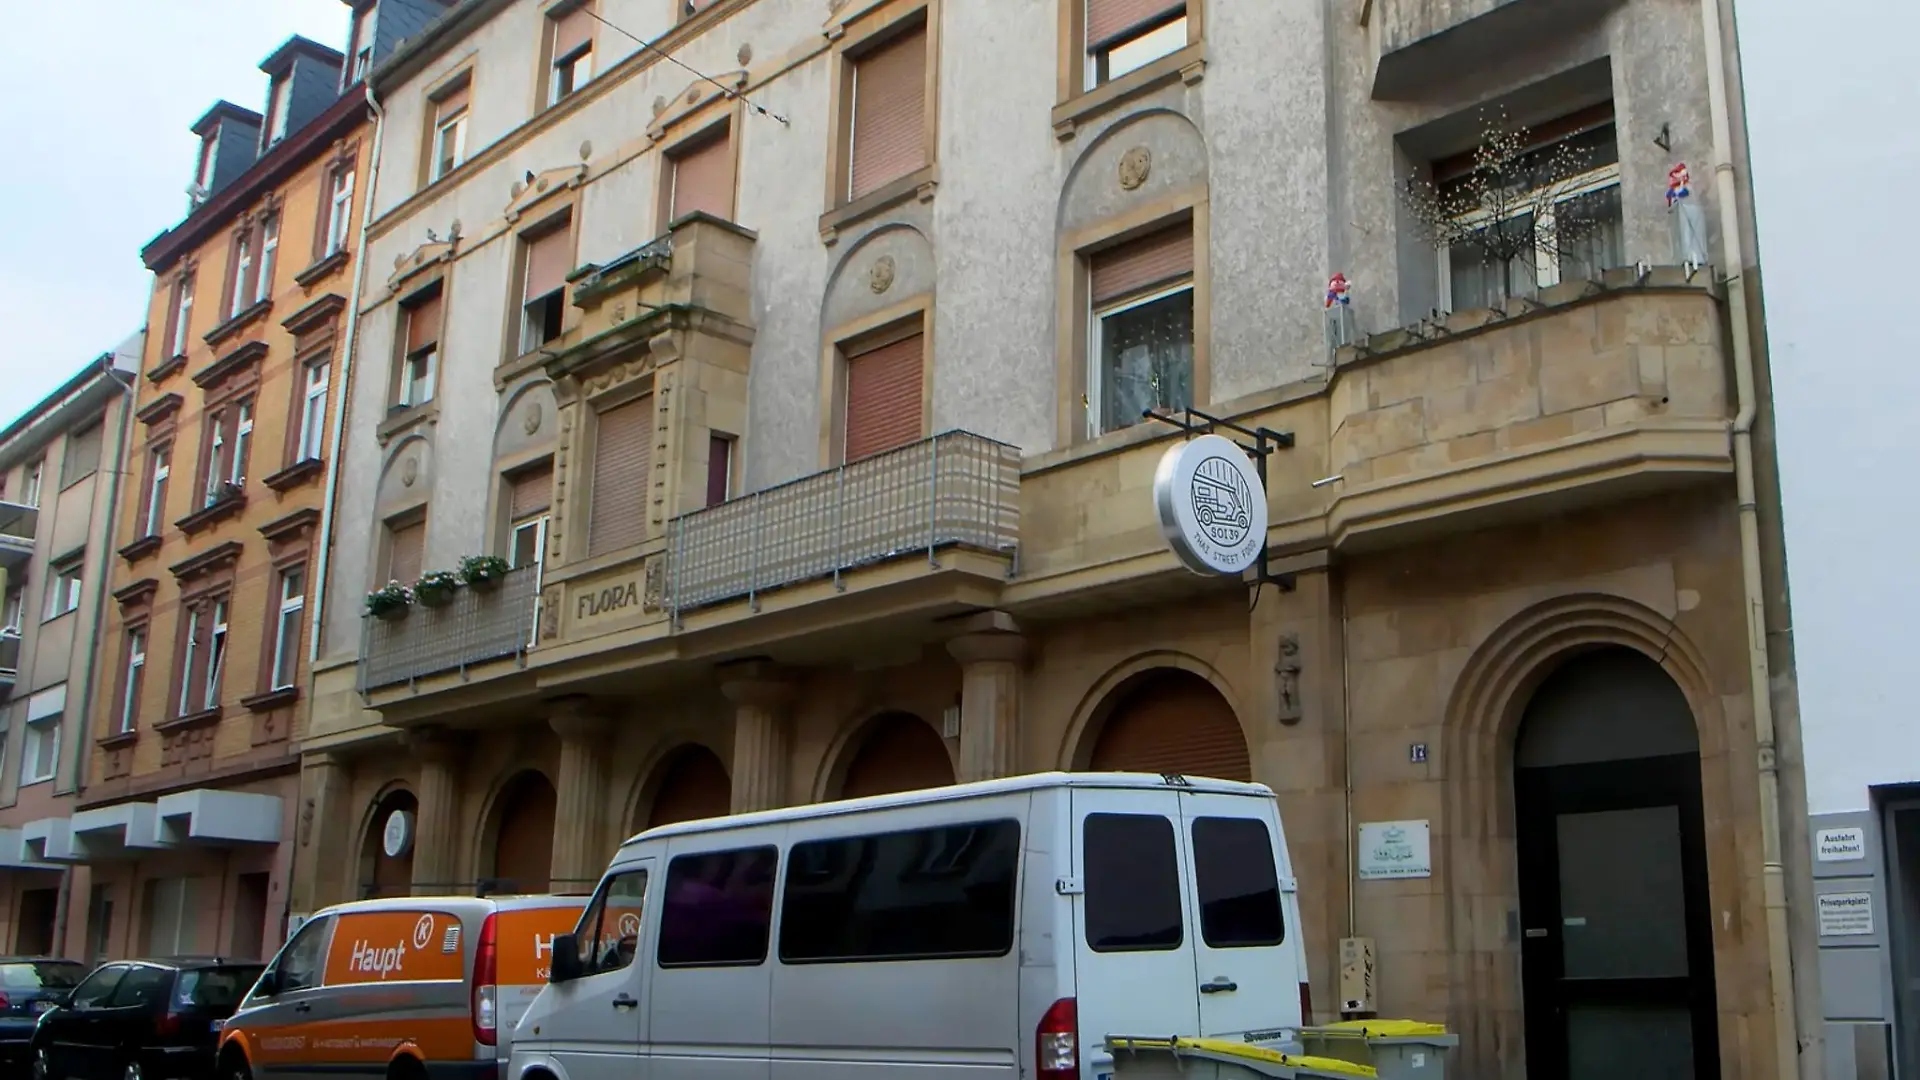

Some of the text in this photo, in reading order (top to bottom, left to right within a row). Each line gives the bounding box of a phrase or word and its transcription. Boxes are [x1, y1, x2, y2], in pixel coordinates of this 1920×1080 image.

[1194, 532, 1256, 565] THAI STREET FOOD
[577, 581, 638, 619] FLORA
[1411, 744, 1426, 762] 17
[1821, 844, 1860, 854] freihalten!
[1824, 834, 1855, 843] Ausfahrt
[349, 939, 406, 980] Haupt
